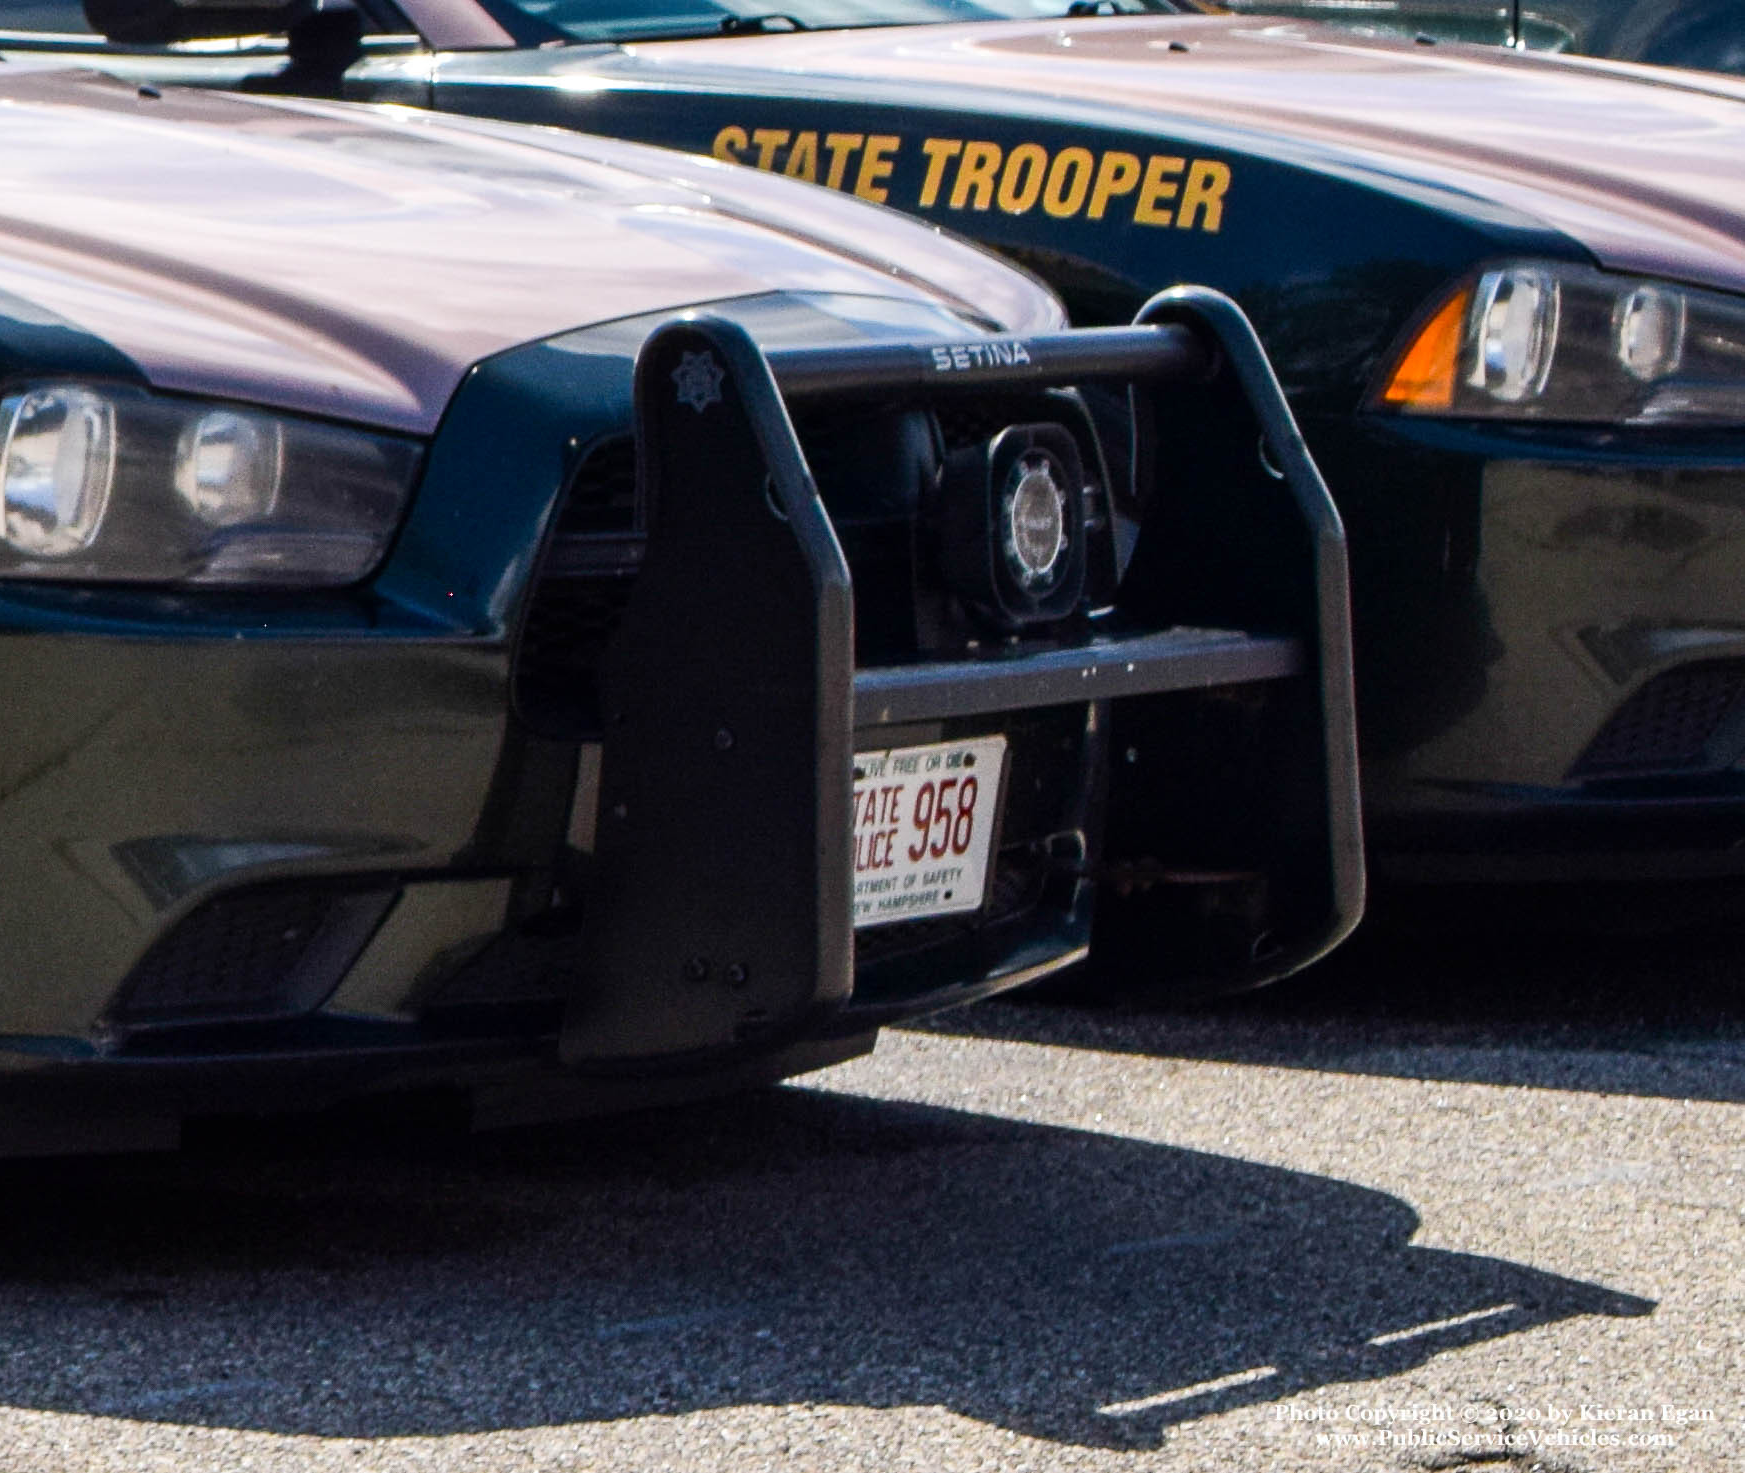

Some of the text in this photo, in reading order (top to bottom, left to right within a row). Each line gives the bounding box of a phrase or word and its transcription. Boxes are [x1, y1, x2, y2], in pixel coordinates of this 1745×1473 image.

[919, 138, 1232, 233] TROOPER
[932, 342, 1030, 370] SETINA
[908, 775, 978, 862] 958
